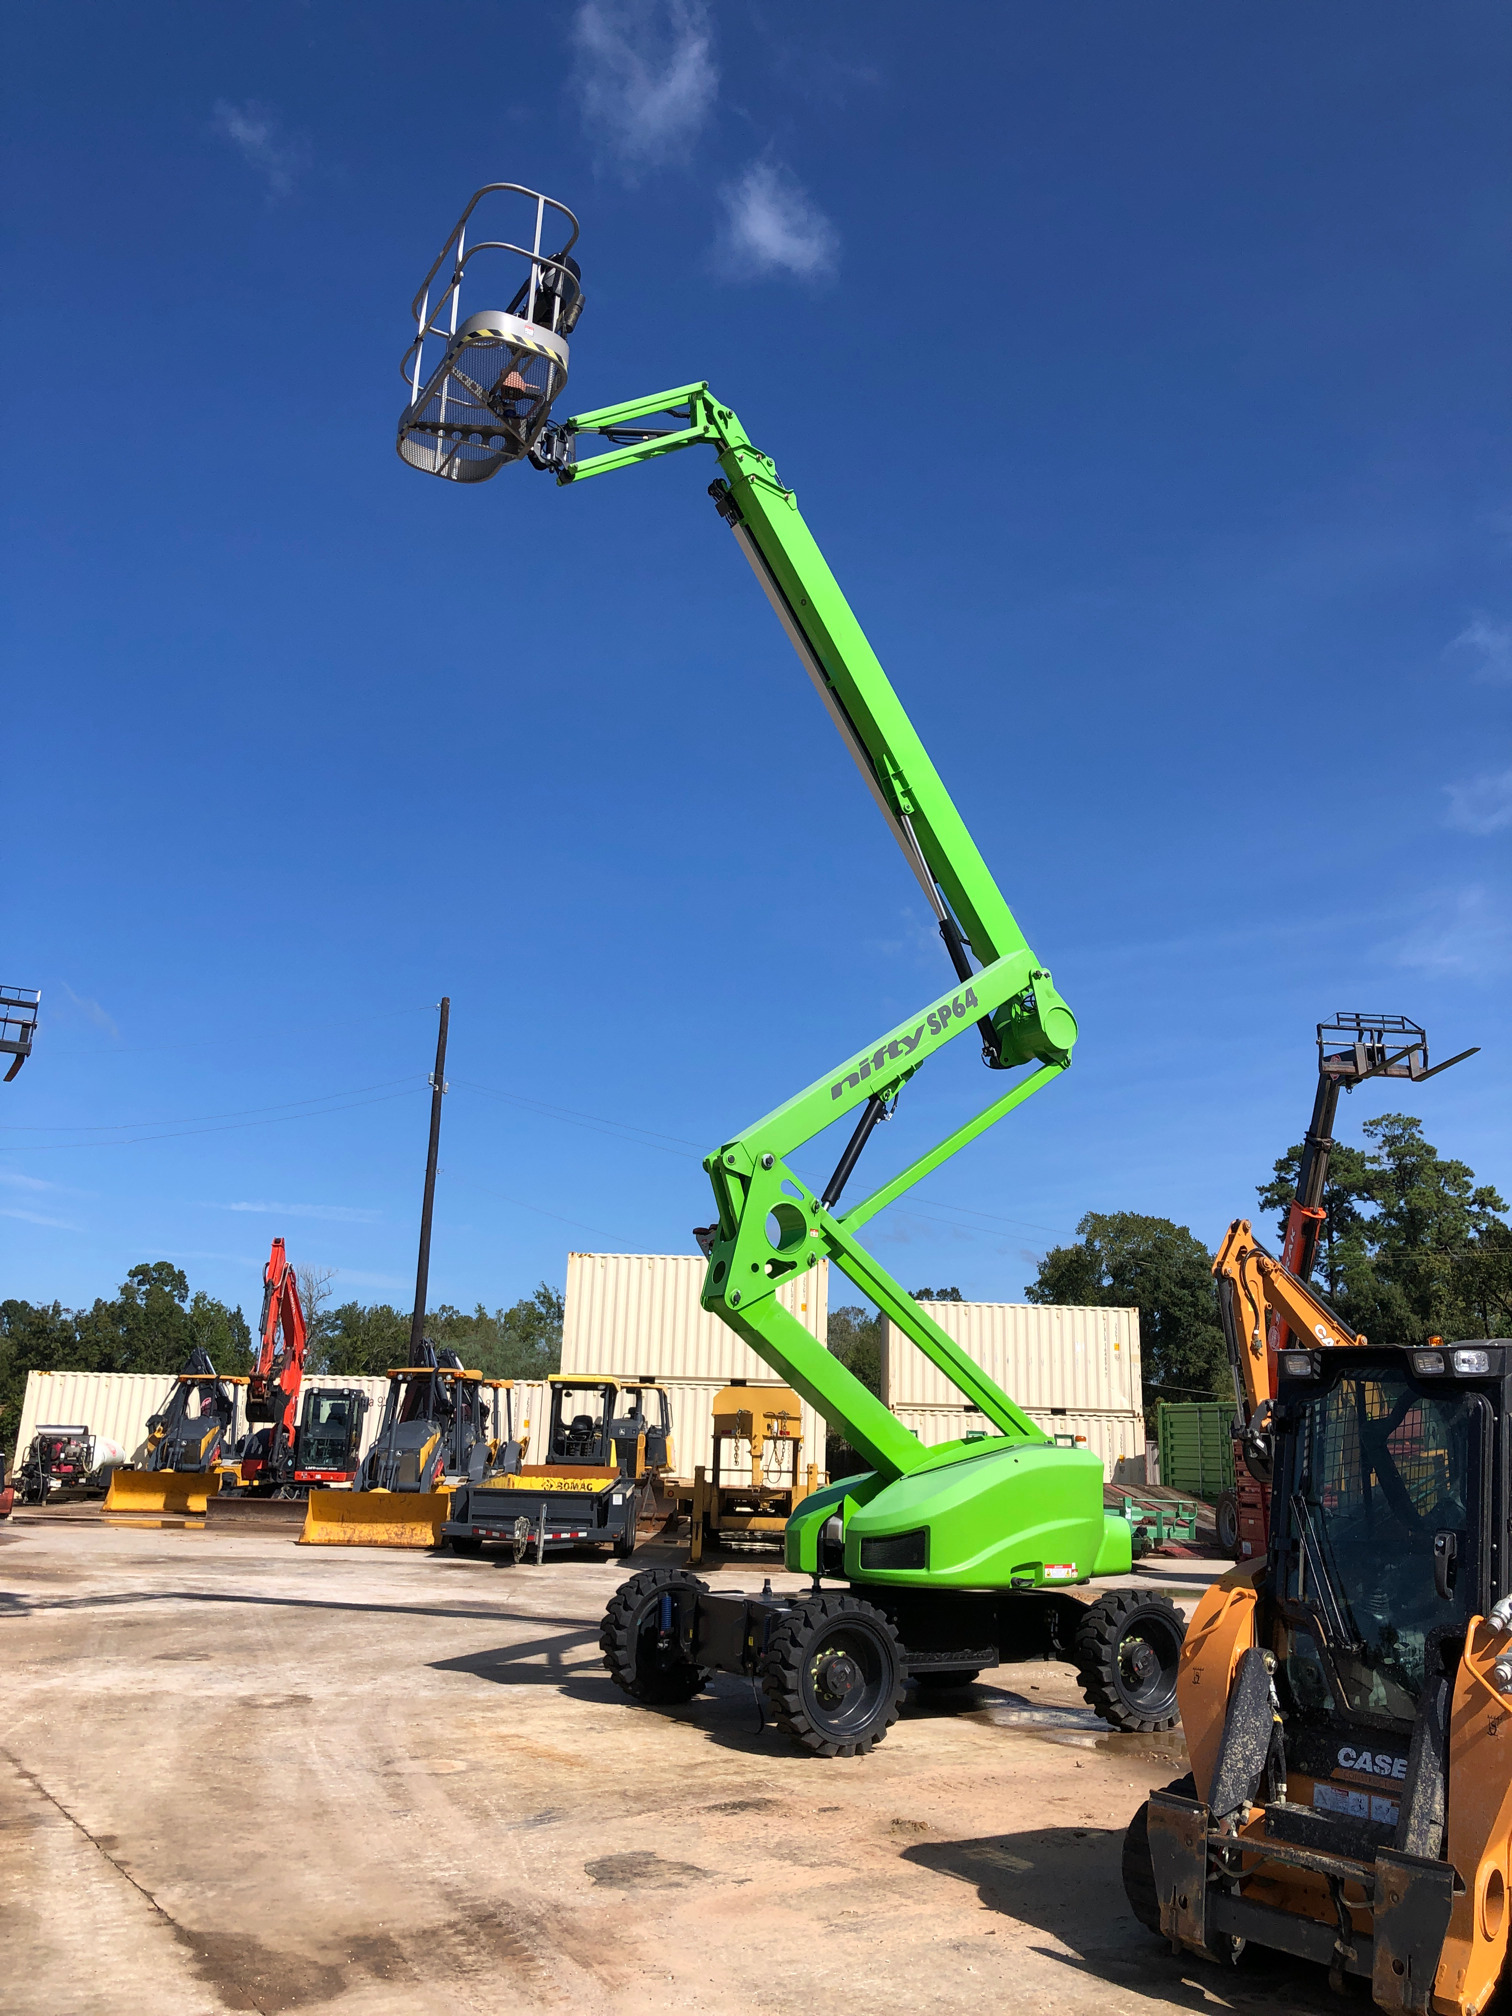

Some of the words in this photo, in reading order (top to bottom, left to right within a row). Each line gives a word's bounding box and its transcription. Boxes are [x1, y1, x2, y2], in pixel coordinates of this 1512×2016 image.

[830, 1024, 926, 1100] nifty
[926, 987, 978, 1036] SP64
[1314, 1324, 1334, 1346] CA
[556, 1482, 593, 1491] BOMAG
[1337, 1747, 1408, 1779] CASE
